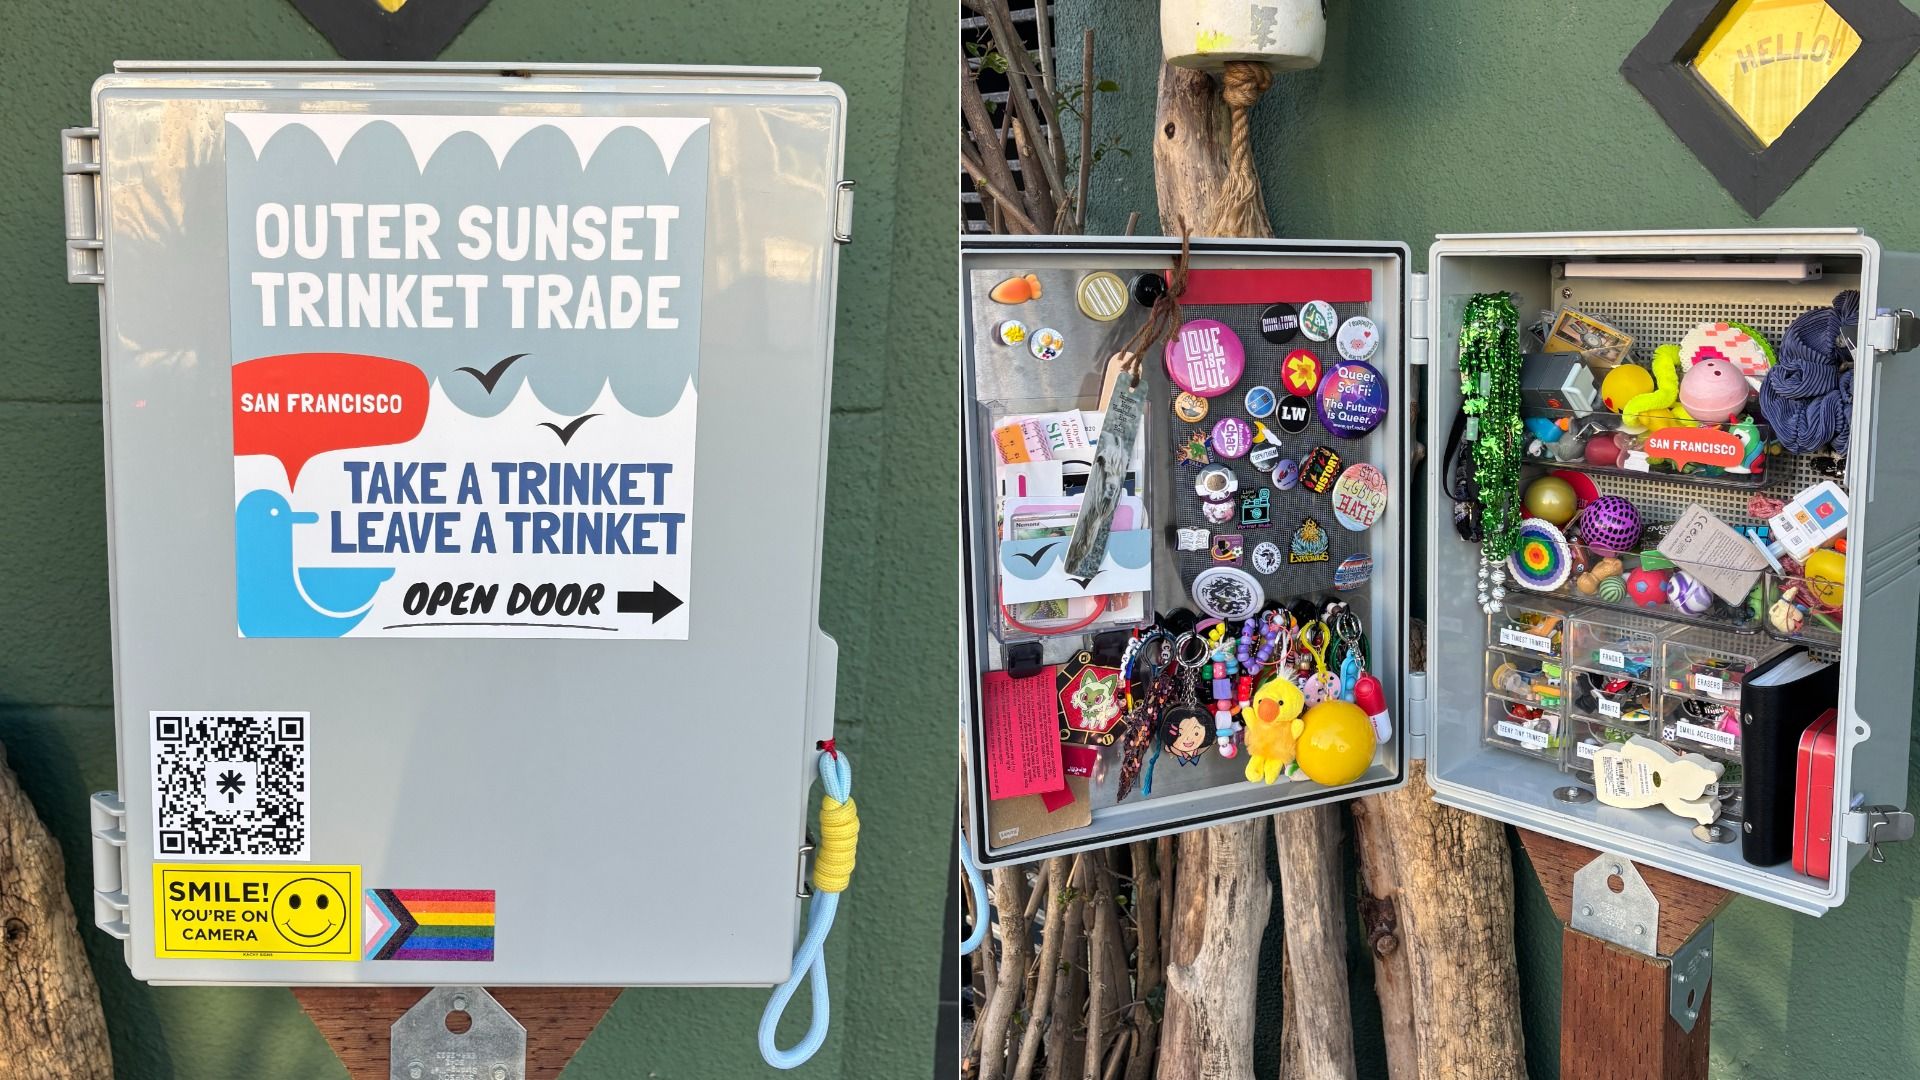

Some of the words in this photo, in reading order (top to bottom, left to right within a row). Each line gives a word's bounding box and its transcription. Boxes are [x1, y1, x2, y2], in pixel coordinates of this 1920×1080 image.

[1736, 31, 1841, 75] HELLO!
[255, 202, 441, 260] OUTER
[457, 204, 679, 262] SUNSET
[251, 272, 488, 329] TRINKET
[502, 274, 681, 329] TRADE
[1181, 327, 1226, 361] LOVE
[1204, 354, 1216, 370] is
[1187, 357, 1231, 392] LOVE
[1338, 367, 1376, 382] Queer
[1338, 382, 1354, 394] Sci
[1358, 385, 1372, 396] Fi:
[240, 393, 280, 414] SAN
[287, 393, 402, 414] FRANCISCO
[1281, 406, 1307, 421] LW
[1325, 398, 1343, 409] The
[1346, 401, 1377, 414] Future
[1327, 410, 1335, 419] is
[1338, 412, 1371, 424] Queer.
[1225, 424, 1237, 451] chat
[1649, 438, 1670, 449] SAN
[1673, 440, 1736, 456] FRANCISCO
[343, 461, 447, 505] TAKE
[456, 462, 483, 505] A
[491, 461, 673, 506] TRINKET
[1314, 453, 1339, 493] HISTORY
[1343, 475, 1384, 509] LGBTQ+
[1336, 493, 1376, 527] HATE
[330, 510, 461, 554] LEAVE
[470, 512, 497, 554] A
[505, 512, 686, 555] TRINKET
[402, 582, 499, 617] OPEN
[505, 582, 607, 616] DOOR
[1697, 678, 1721, 690] ERASERS
[1697, 731, 1732, 745] ACCESSORIES
[168, 881, 270, 903] SMILE!
[171, 908, 236, 922] YOU'RE
[241, 909, 269, 923] ON
[182, 927, 258, 942] CAMERA
